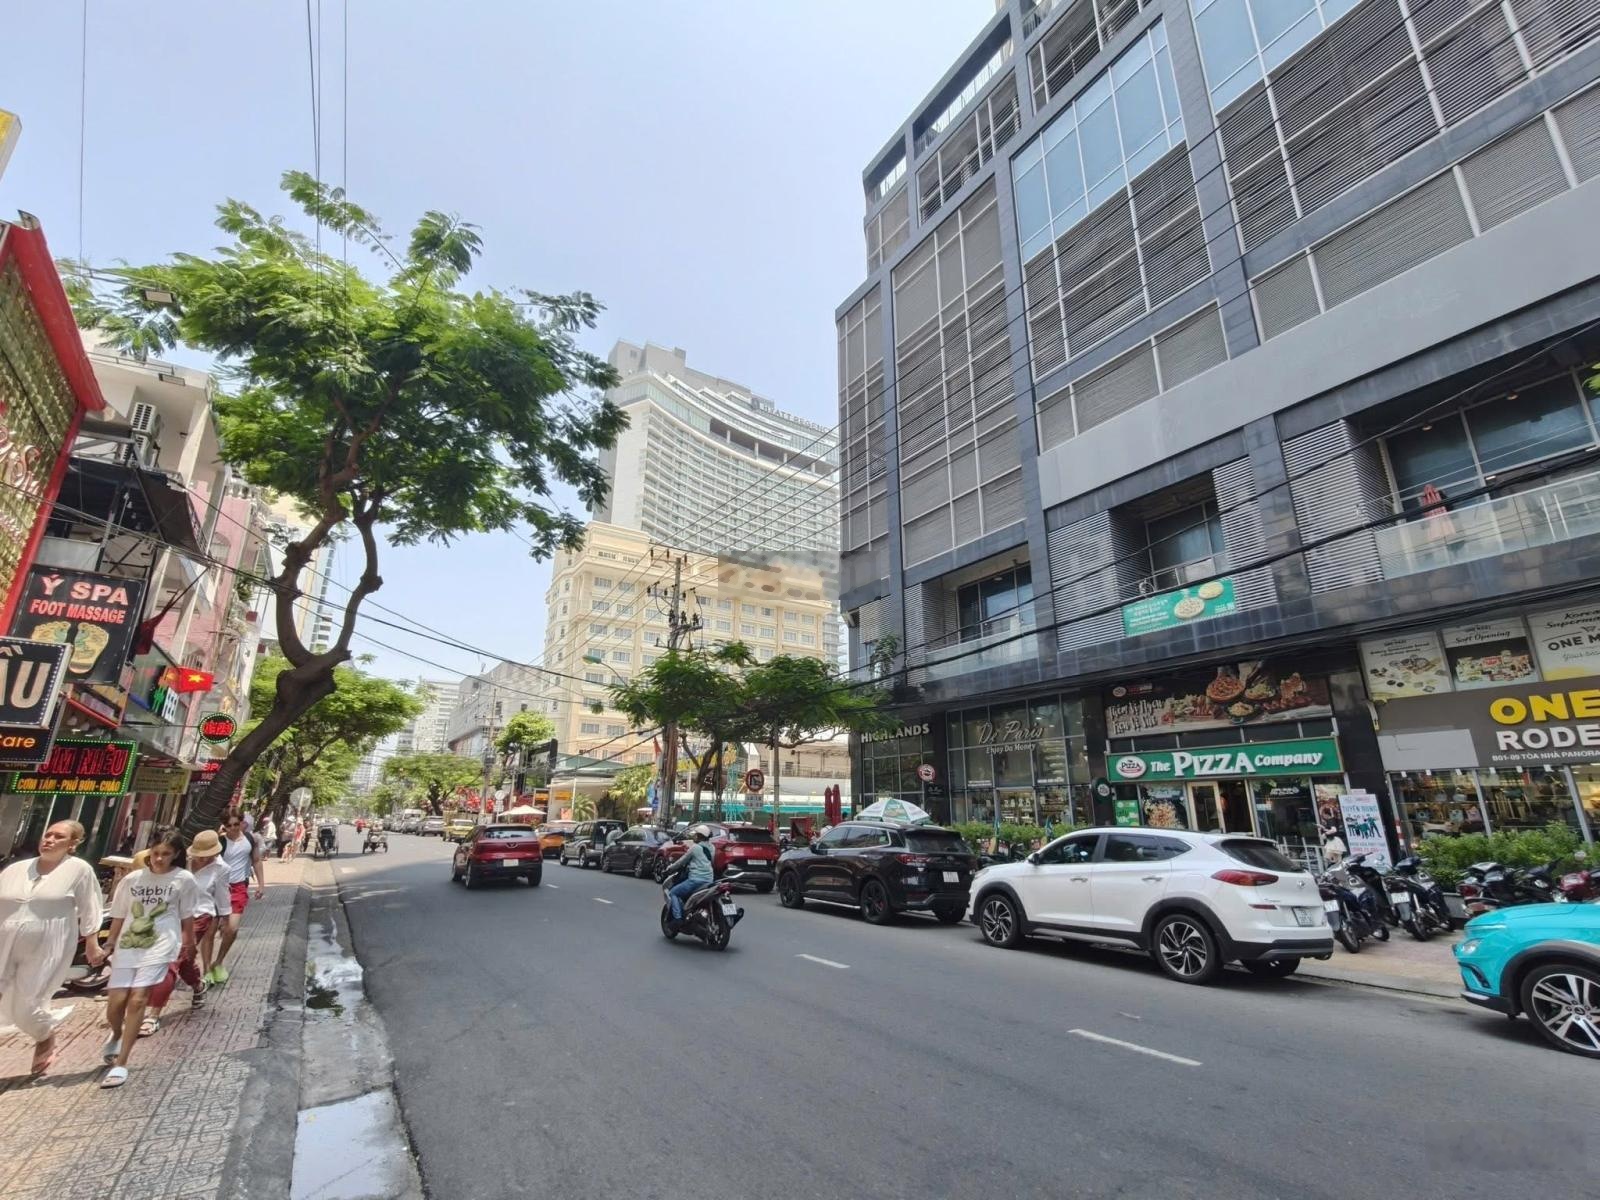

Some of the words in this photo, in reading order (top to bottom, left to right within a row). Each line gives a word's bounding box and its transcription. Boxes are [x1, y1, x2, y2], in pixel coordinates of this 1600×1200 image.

[70, 581, 129, 606] SPA
[30, 599, 66, 616] FOOT
[67, 605, 126, 624] MASSAGE
[1548, 636, 1583, 651] ONE
[1489, 688, 1600, 725] ONE
[860, 722, 930, 744] HIGHLANDS
[1003, 720, 1045, 741] Paris
[1150, 760, 1171, 772] The
[1172, 752, 1256, 777] PIZZA
[1255, 753, 1323, 767] Company
